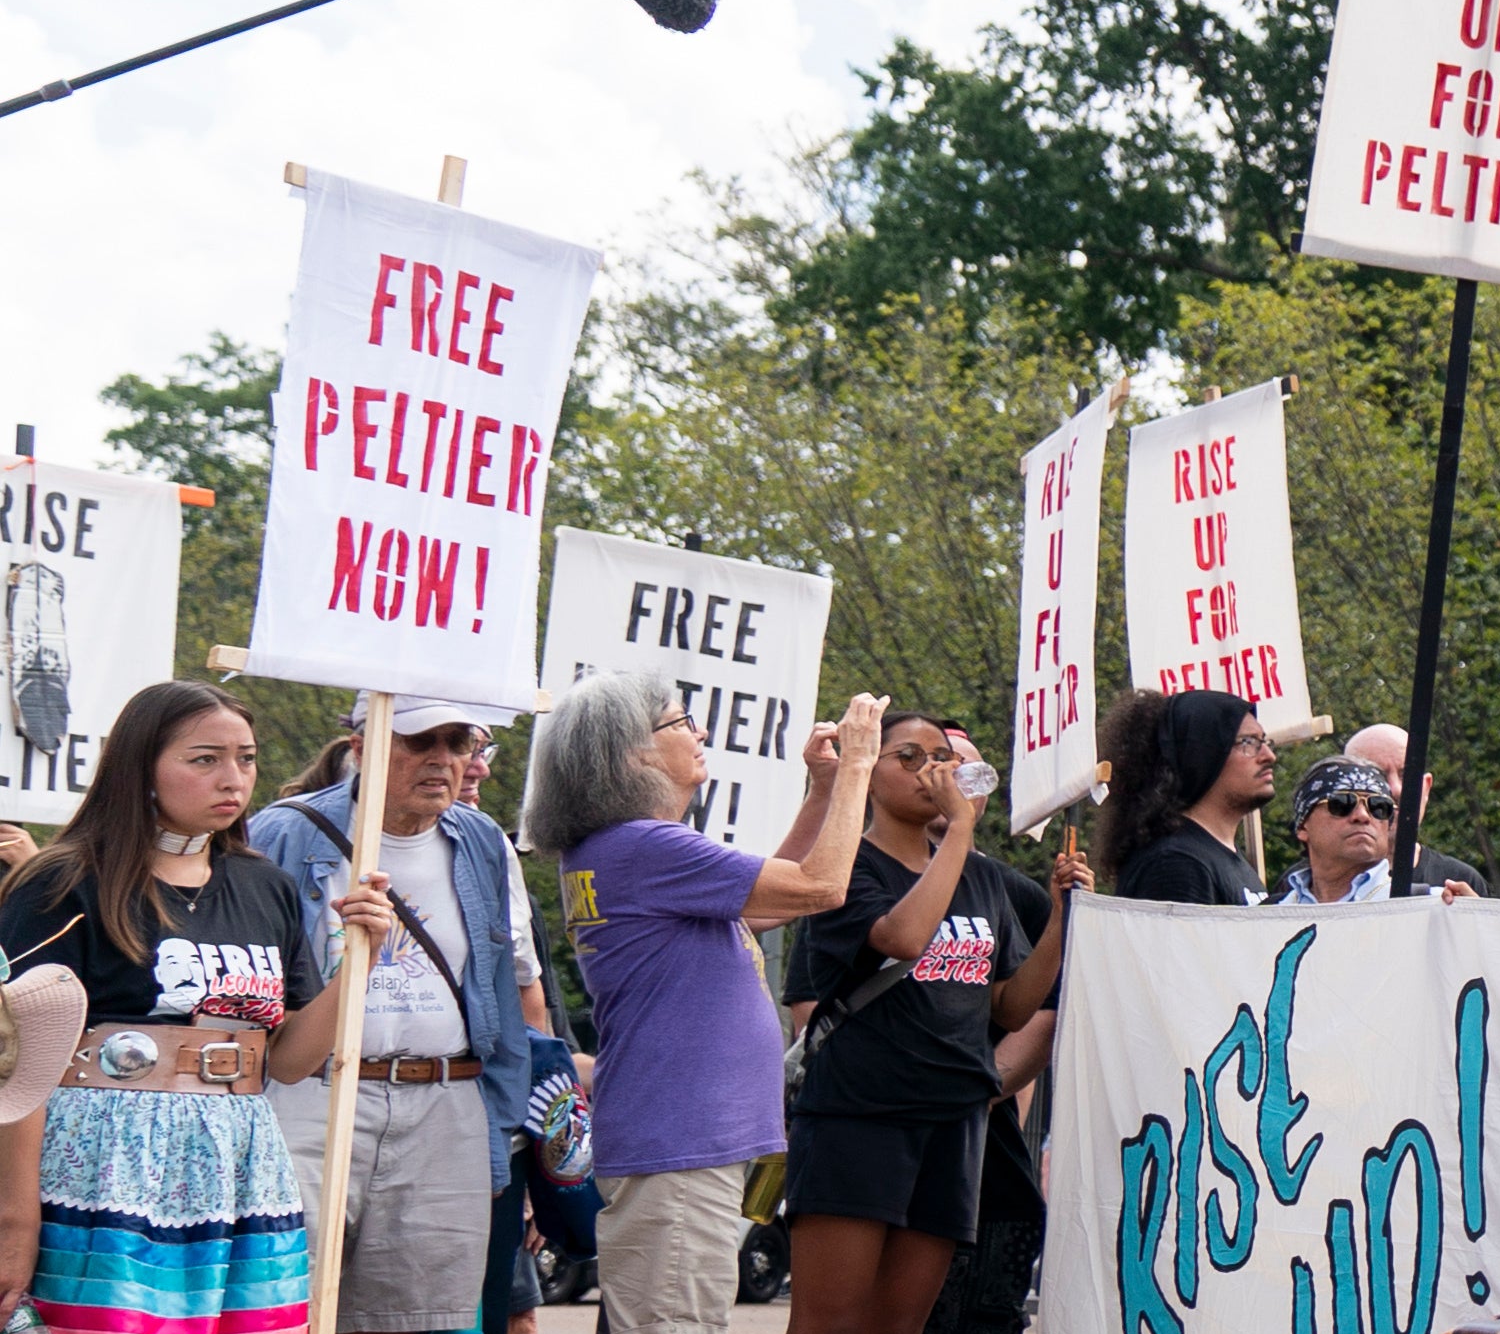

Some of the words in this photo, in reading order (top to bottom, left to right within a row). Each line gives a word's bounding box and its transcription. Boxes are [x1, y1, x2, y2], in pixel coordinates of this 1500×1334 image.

[367, 252, 516, 377] FREE
[303, 377, 542, 517] PELTIER
[1174, 435, 1238, 504] RISE
[327, 516, 490, 634] NOW!
[1193, 511, 1228, 572] UP
[625, 580, 766, 665] FREE
[1186, 580, 1239, 646] FOR
[911, 956, 992, 986] ELTIER
